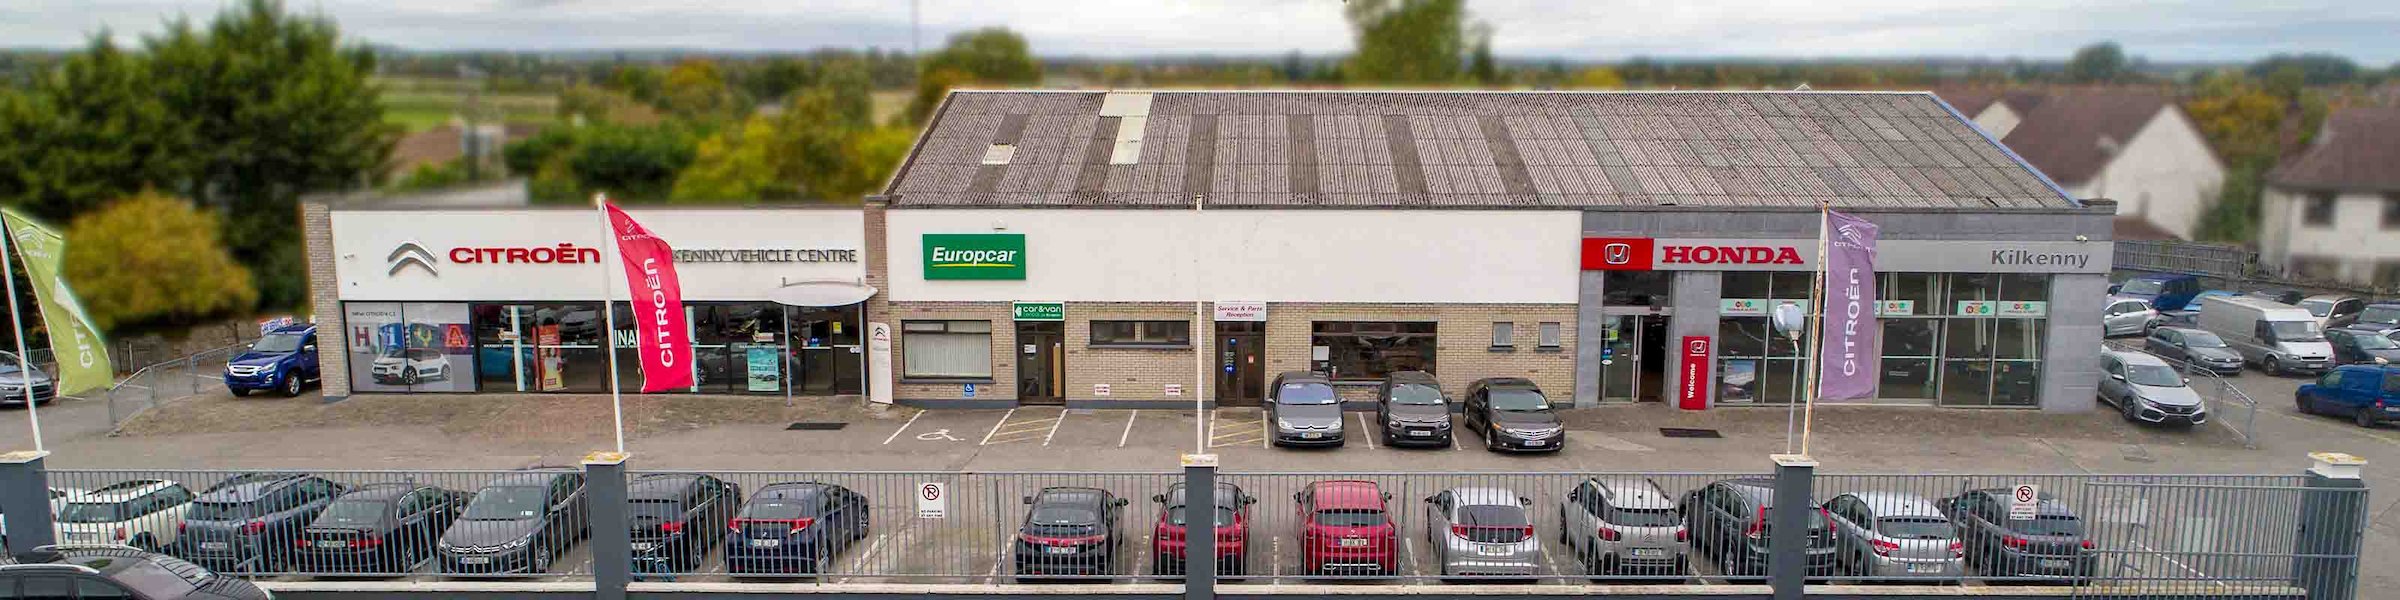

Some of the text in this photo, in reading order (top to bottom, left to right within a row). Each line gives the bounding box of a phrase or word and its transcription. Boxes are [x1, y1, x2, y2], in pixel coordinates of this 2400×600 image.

[449, 242, 601, 264] CITROËN
[672, 250, 858, 263] KENNY VEHICLE CENTRE
[932, 246, 1017, 265] Europcar
[1662, 245, 1804, 265] HONDA
[1991, 249, 2089, 269] Kilkenny
[1022, 305, 1062, 313] car&van
[614, 329, 637, 346] INA
[1687, 363, 1696, 399] Welcome
